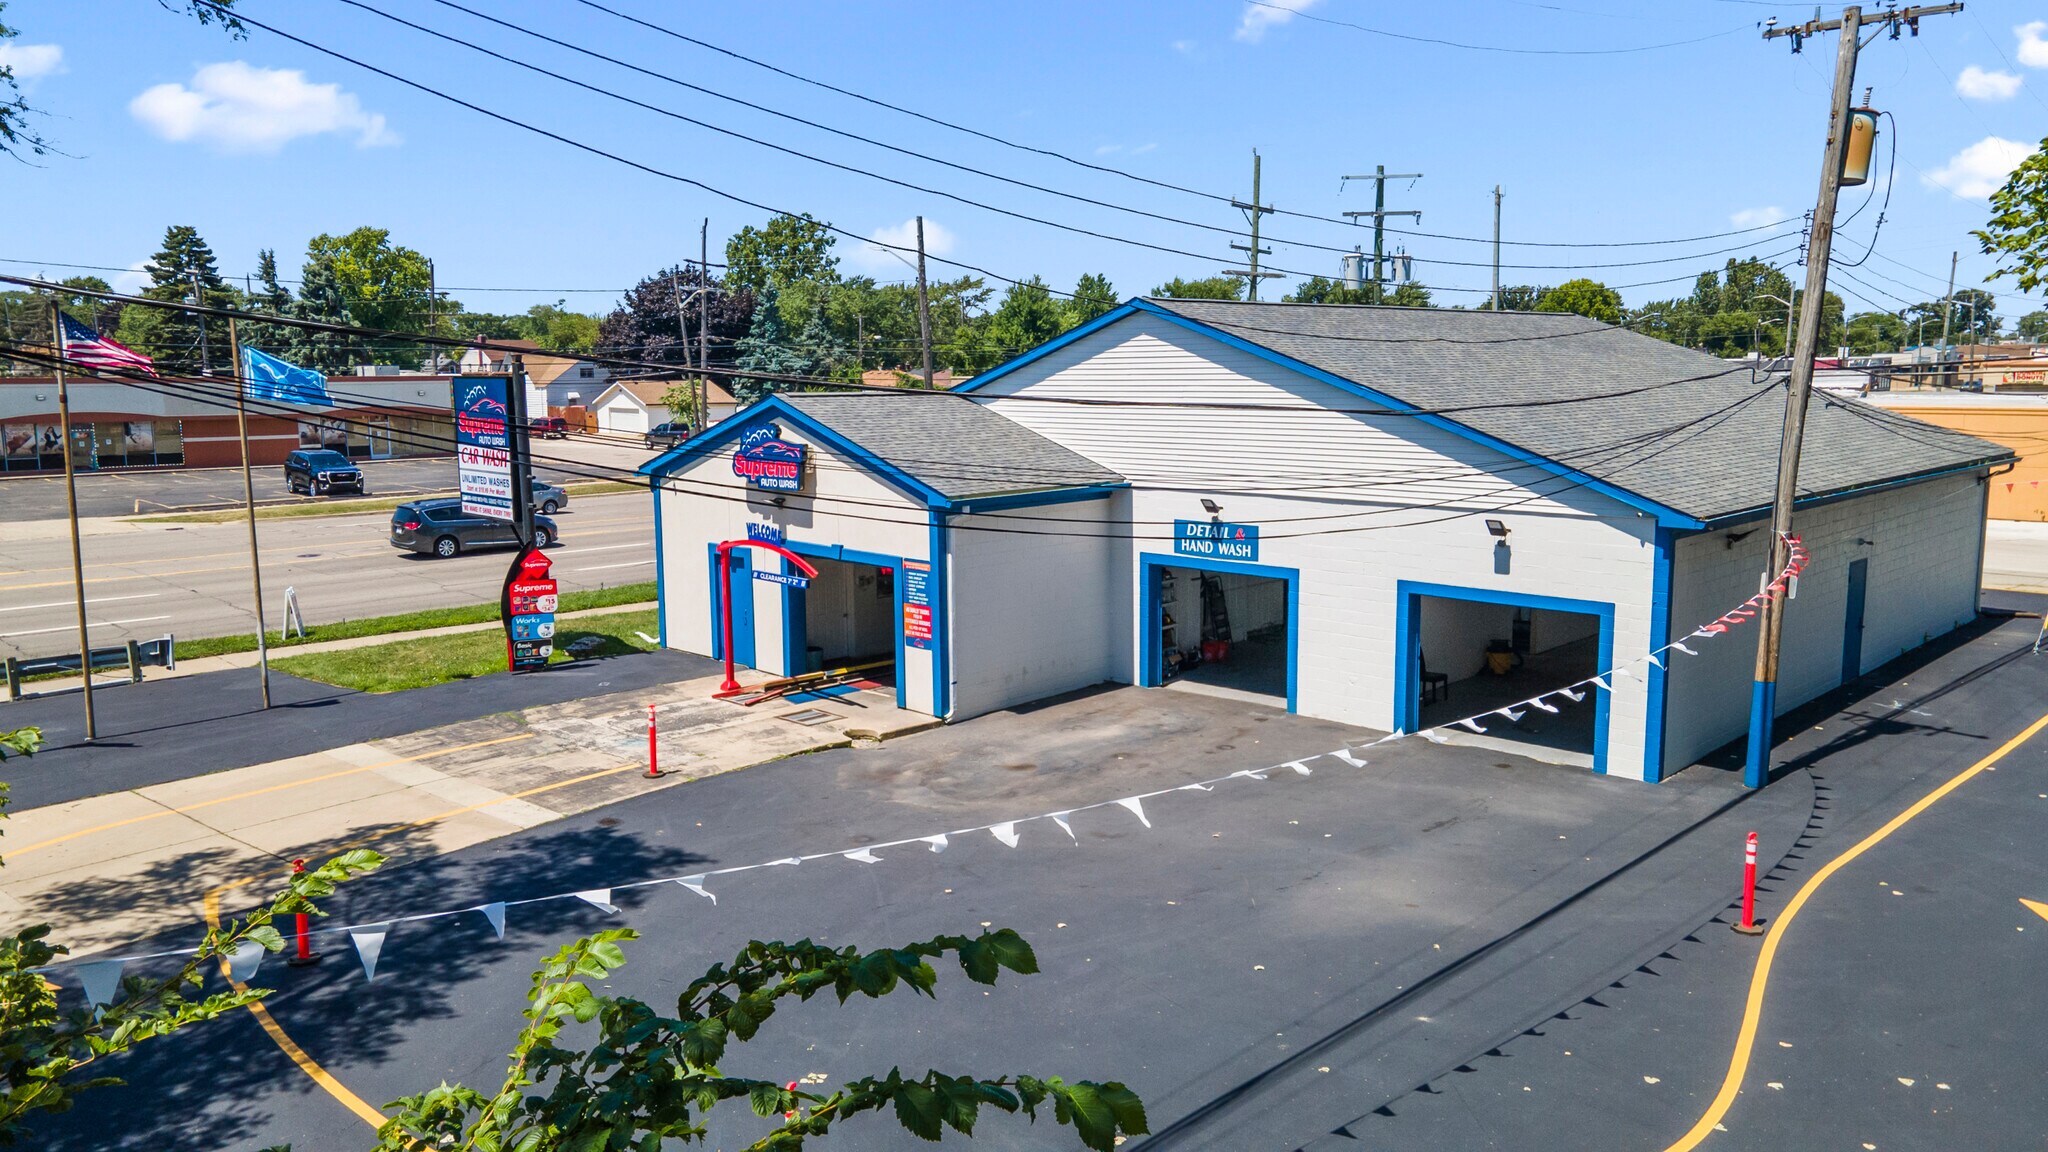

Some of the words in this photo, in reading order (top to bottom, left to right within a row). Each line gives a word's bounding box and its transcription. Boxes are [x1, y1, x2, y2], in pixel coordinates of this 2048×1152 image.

[479, 436, 491, 444] AUTO
[492, 437, 505, 446] WASH
[461, 447, 478, 464] CAR
[482, 449, 507, 467] WASH
[735, 455, 797, 480] Supreme
[462, 475, 487, 485] UNLIMITED
[488, 477, 510, 488] WASHES
[761, 478, 778, 488] AUTO
[779, 479, 798, 490] WASH
[746, 522, 782, 541] WELCOME
[1187, 523, 1230, 538] DETAIL
[1235, 528, 1245, 540] &
[1181, 539, 1213, 553] HAND
[1218, 543, 1251, 557] WASH
[760, 573, 787, 584] CLEARANCE
[514, 584, 553, 593] Supreme
